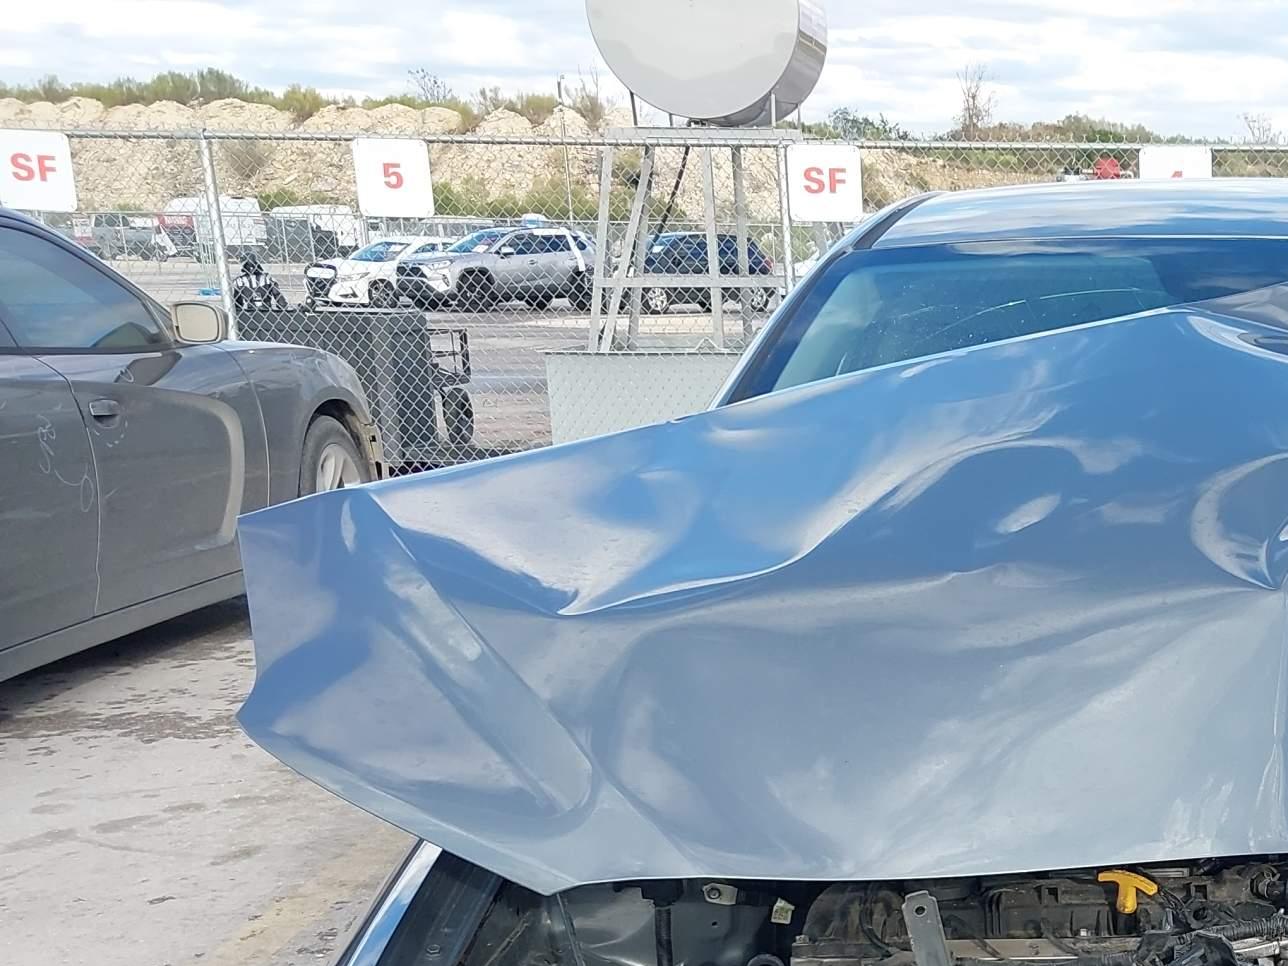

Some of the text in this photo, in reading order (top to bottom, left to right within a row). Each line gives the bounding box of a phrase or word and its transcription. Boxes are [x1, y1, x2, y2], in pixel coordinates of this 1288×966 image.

[9, 152, 57, 183] SF
[382, 162, 404, 190] 5
[803, 166, 847, 195] SF
